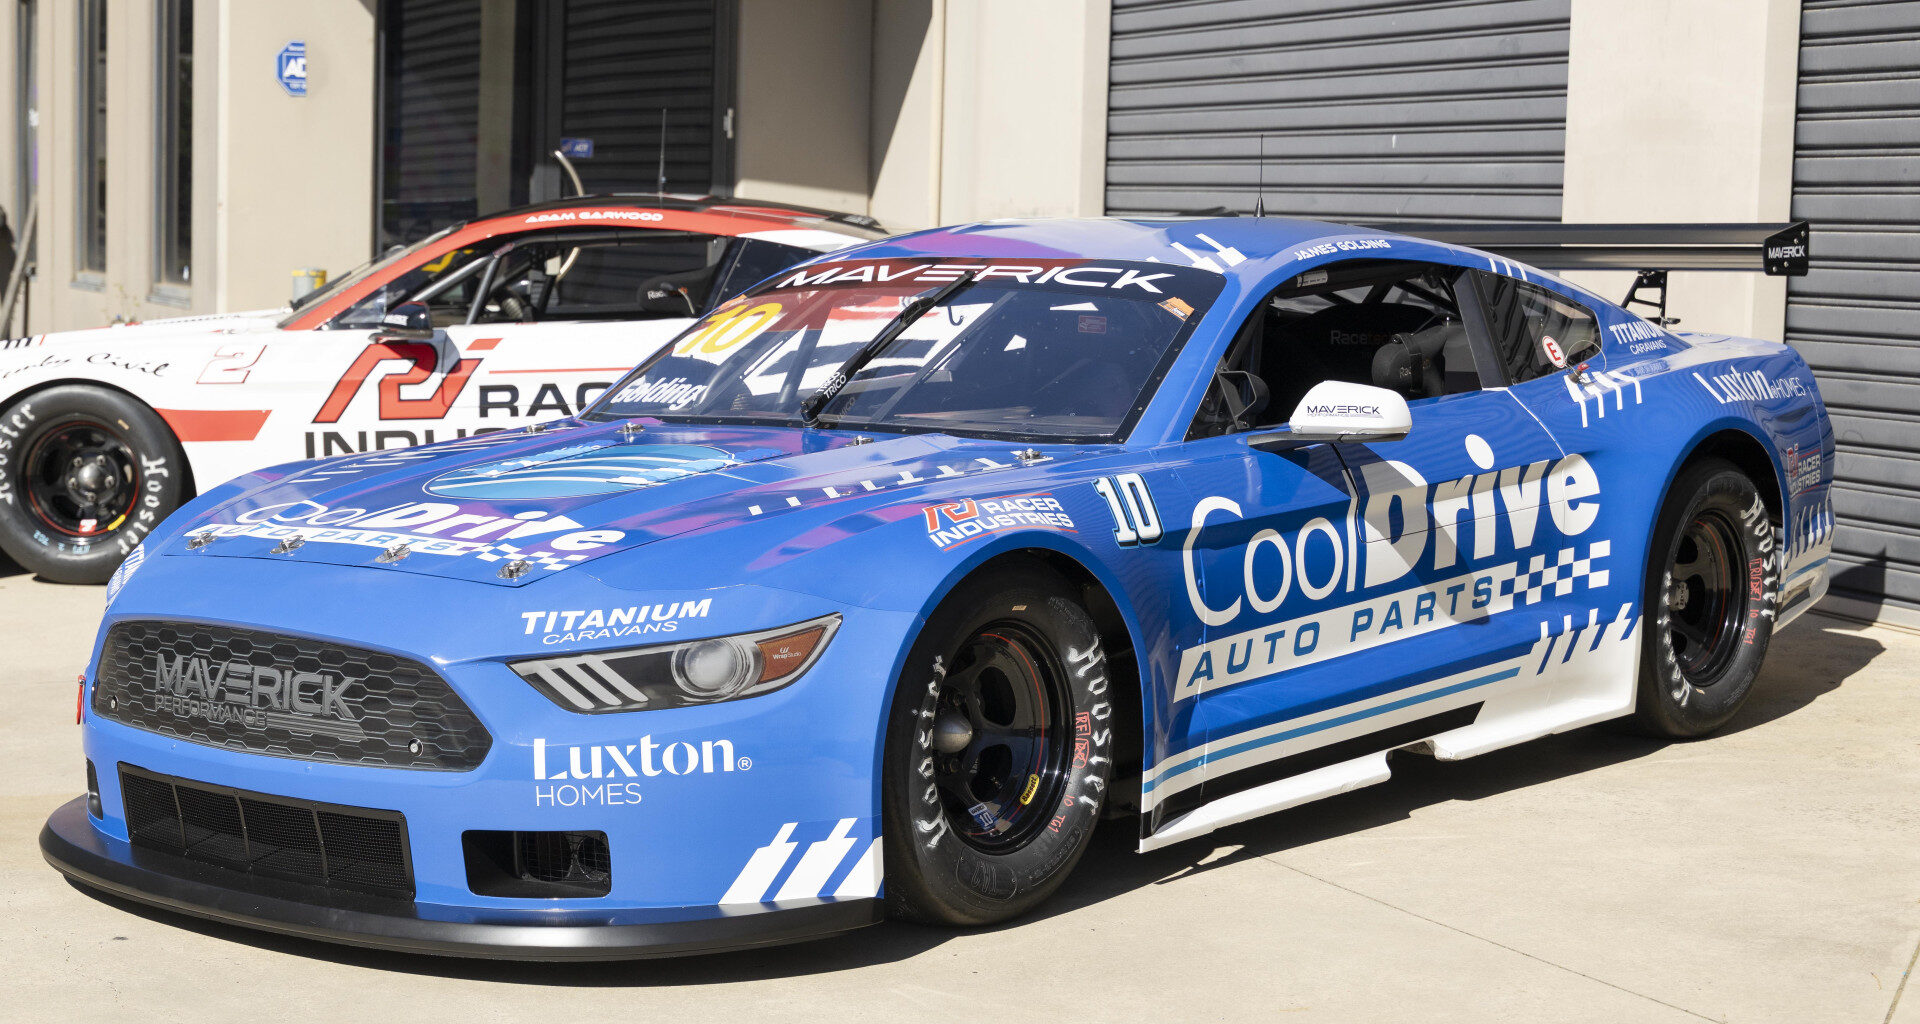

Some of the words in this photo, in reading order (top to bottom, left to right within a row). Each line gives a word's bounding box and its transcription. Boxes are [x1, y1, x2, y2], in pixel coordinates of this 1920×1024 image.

[525, 212, 576, 223] ADAM
[579, 211, 664, 222] GARWOOD
[1294, 242, 1338, 261] JAMES
[1336, 239, 1391, 251] GOLDING
[1768, 245, 1806, 259] MAVERICK
[776, 264, 1176, 294] MAVERICK
[678, 303, 783, 354] 10
[1546, 342, 1562, 362] E
[1629, 339, 1667, 355] CARAVANS
[87, 352, 170, 378] Civil
[823, 374, 847, 399] TRICO
[1772, 377, 1806, 398] HOMES
[1307, 405, 1381, 415] MAVERICK
[982, 498, 1063, 515] RACER
[1091, 472, 1165, 549] 10
[929, 512, 1075, 548] INDUSTRIES
[1183, 434, 1600, 627] CoolDrive
[521, 599, 713, 635] TITANIUM
[543, 620, 678, 645] CARAVANS
[1187, 621, 1320, 688] AUTO
[1350, 576, 1493, 643] PARTS
[155, 653, 356, 719] MAVERICK
[154, 694, 268, 727] PERFORMANCE
[536, 783, 642, 807] HOMES
[979, 811, 994, 827] 10
